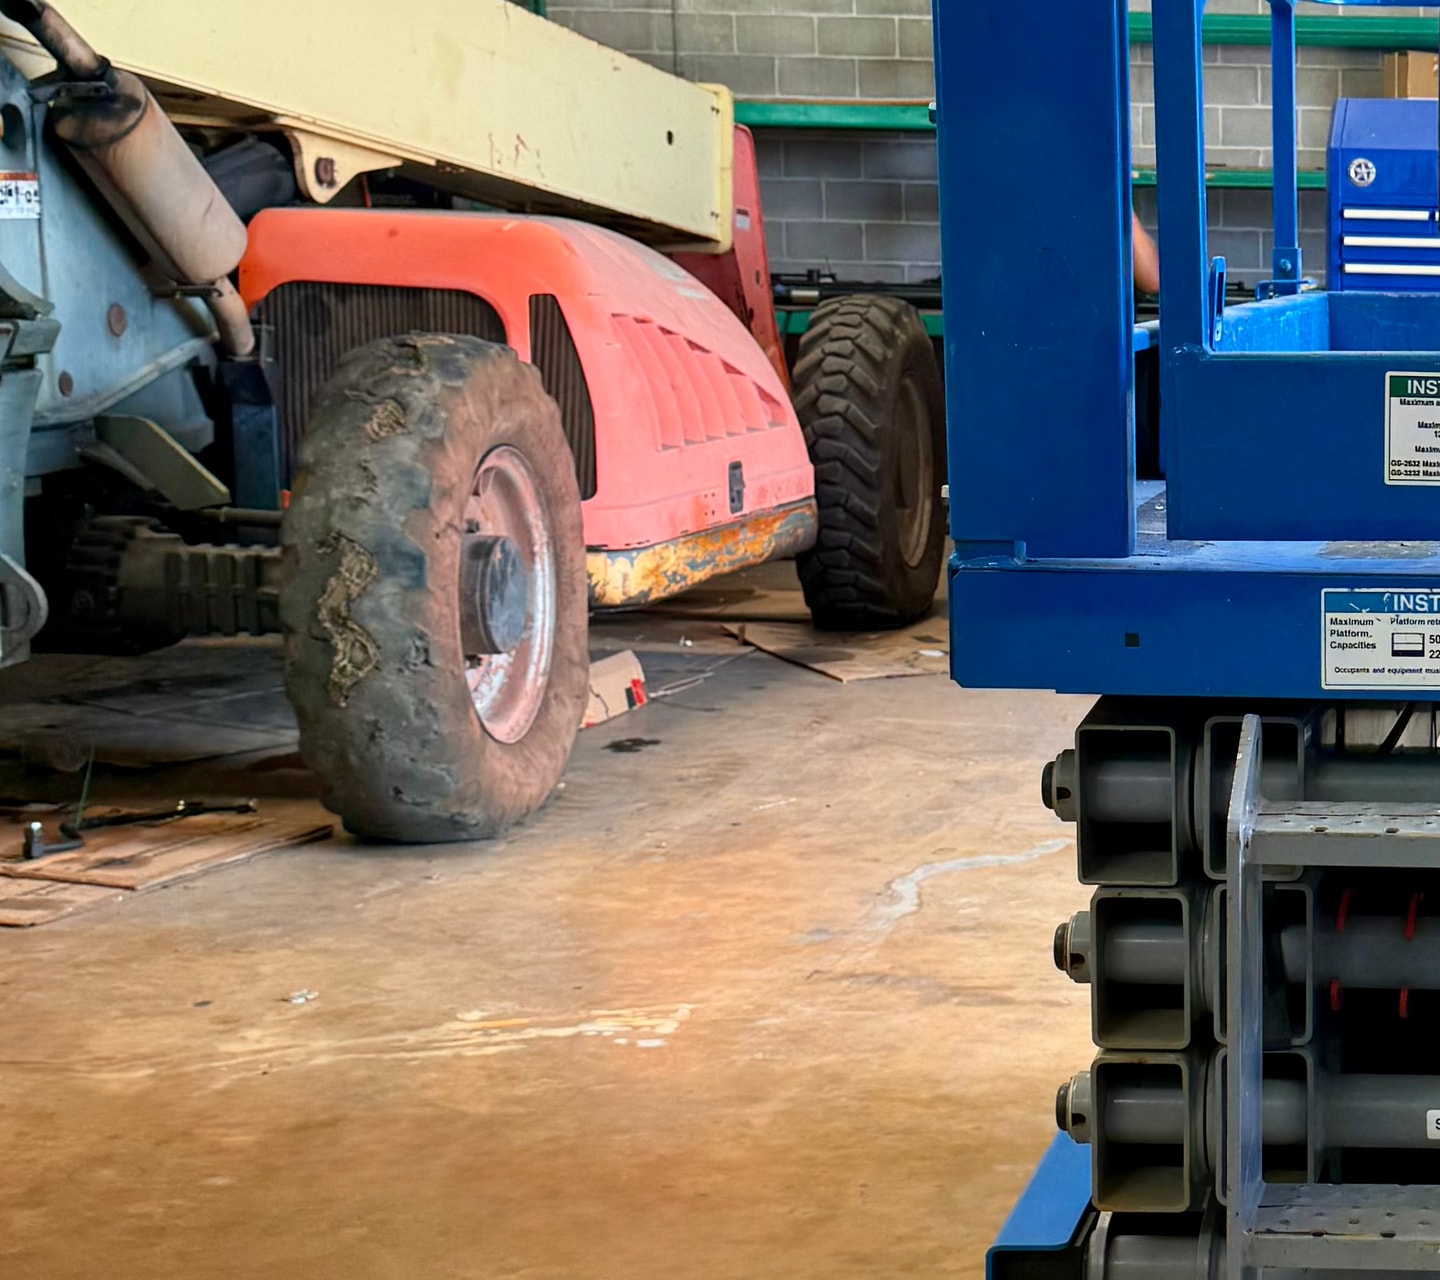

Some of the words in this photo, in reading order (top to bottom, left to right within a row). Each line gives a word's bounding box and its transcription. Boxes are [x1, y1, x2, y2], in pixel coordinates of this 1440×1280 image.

[1400, 398, 1434, 406] Maximum
[1330, 618, 1374, 626] Maximum
[1390, 617, 1425, 625] Platform
[1330, 641, 1376, 650] Capacities
[1334, 667, 1370, 675] Occupants
[1388, 667, 1423, 675] equipment
